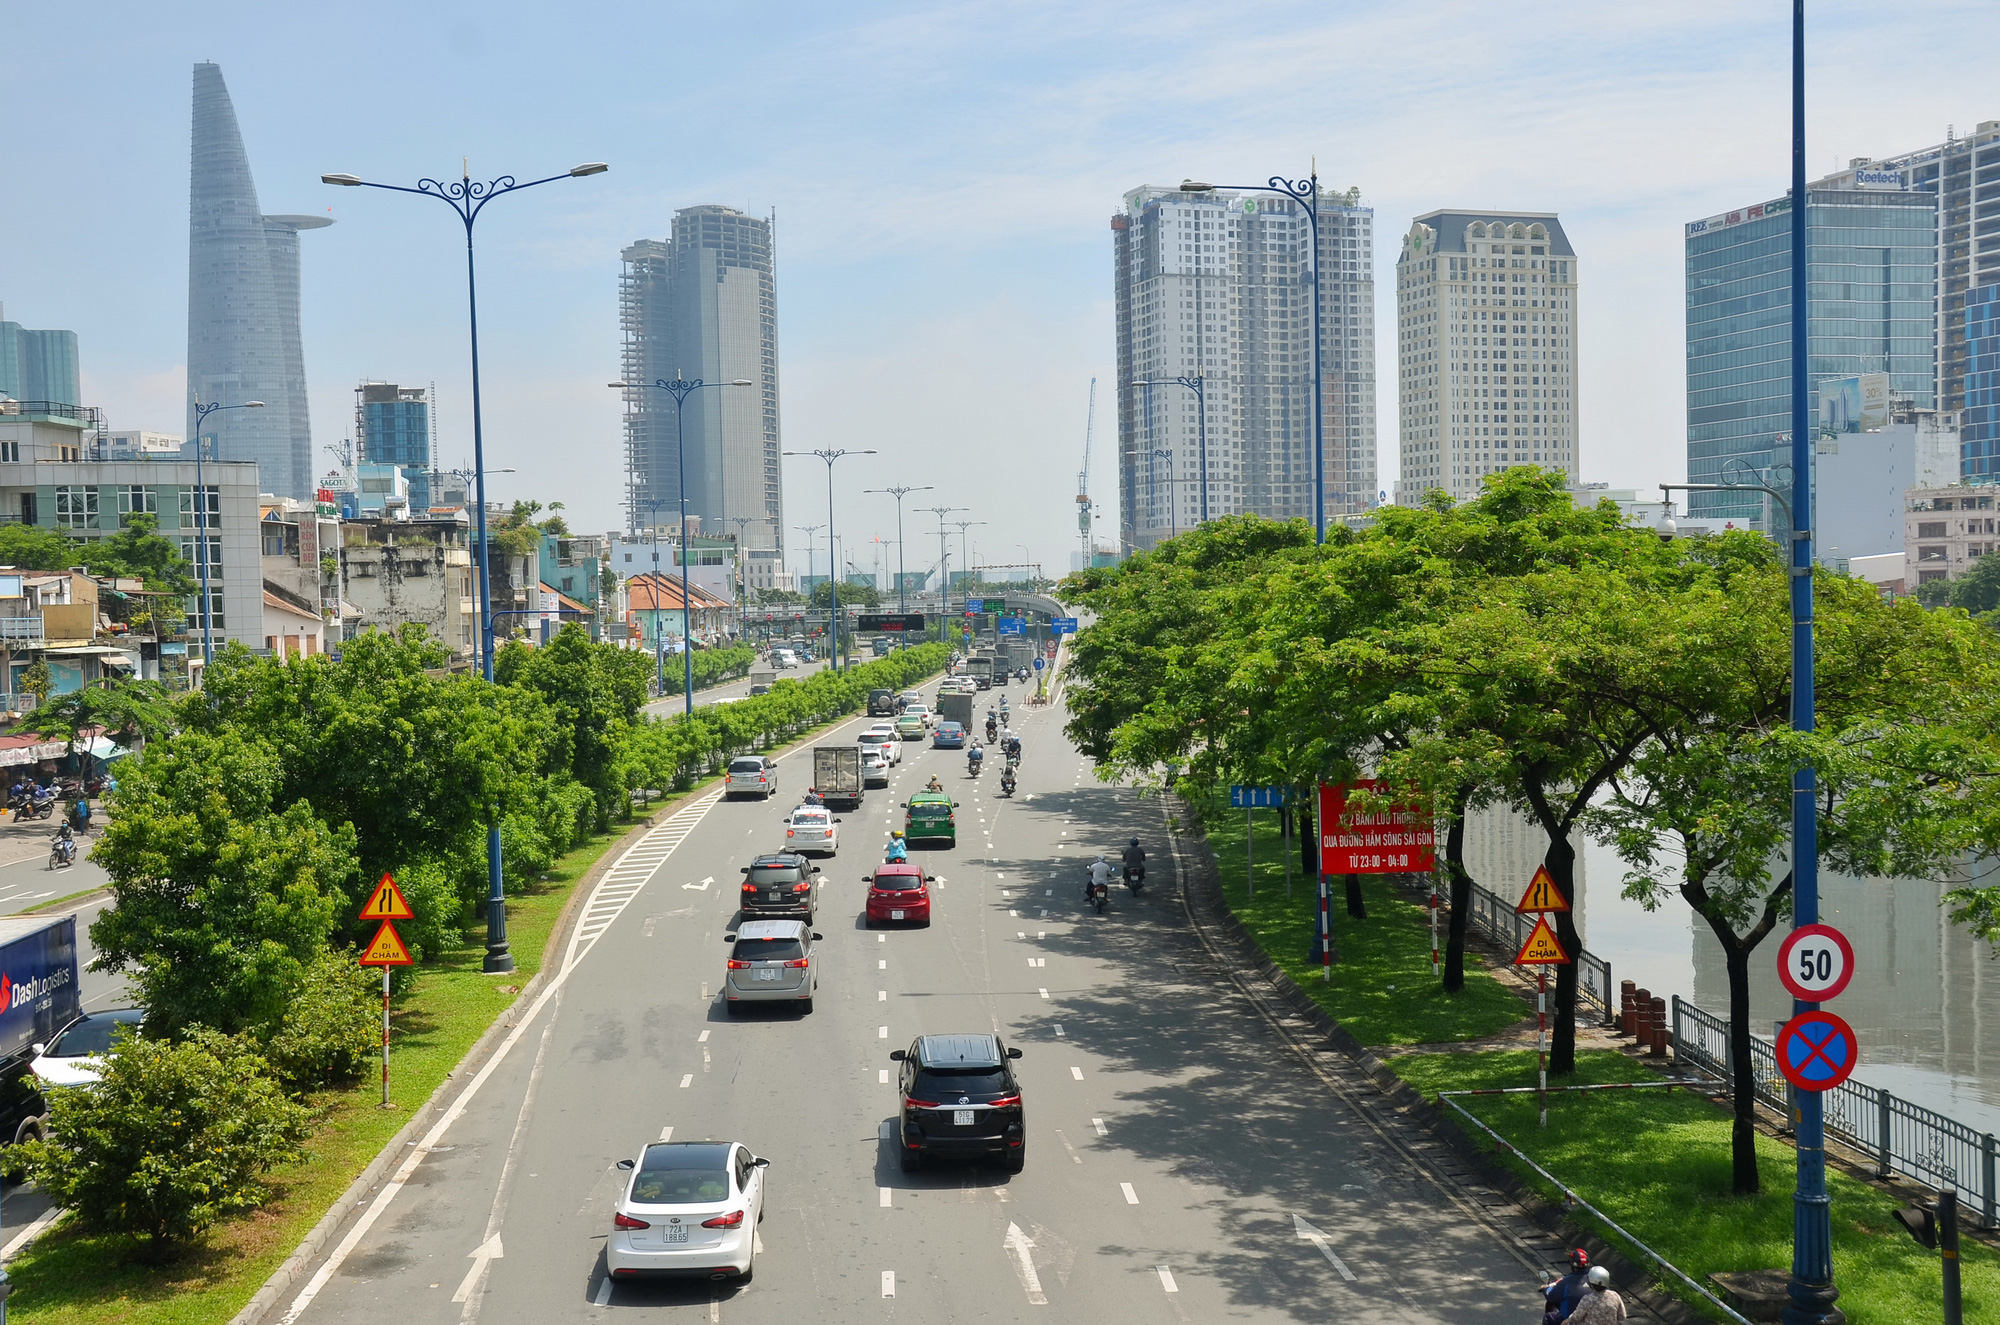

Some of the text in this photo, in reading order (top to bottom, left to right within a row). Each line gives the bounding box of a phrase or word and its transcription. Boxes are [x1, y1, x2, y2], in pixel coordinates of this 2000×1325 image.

[1856, 170, 1901, 183] Reetech
[1747, 206, 1764, 219] FE
[1690, 221, 1707, 234] REE
[1866, 387, 1882, 399] 30%
[1324, 835, 1337, 848] QUA
[1339, 832, 1364, 847] ĐƯỜNG
[1365, 829, 1380, 846] HẦM
[1382, 831, 1402, 846] SÔNG
[1349, 853, 1358, 868] TỪ
[1360, 855, 1380, 868] 23:00
[1388, 854, 1408, 867] 04:00
[1529, 948, 1557, 958] CHẬM
[1800, 949, 1831, 981] 50
[12, 975, 38, 1009] Dash
[38, 968, 70, 996] Logistics
[669, 1225, 682, 1233] 72A
